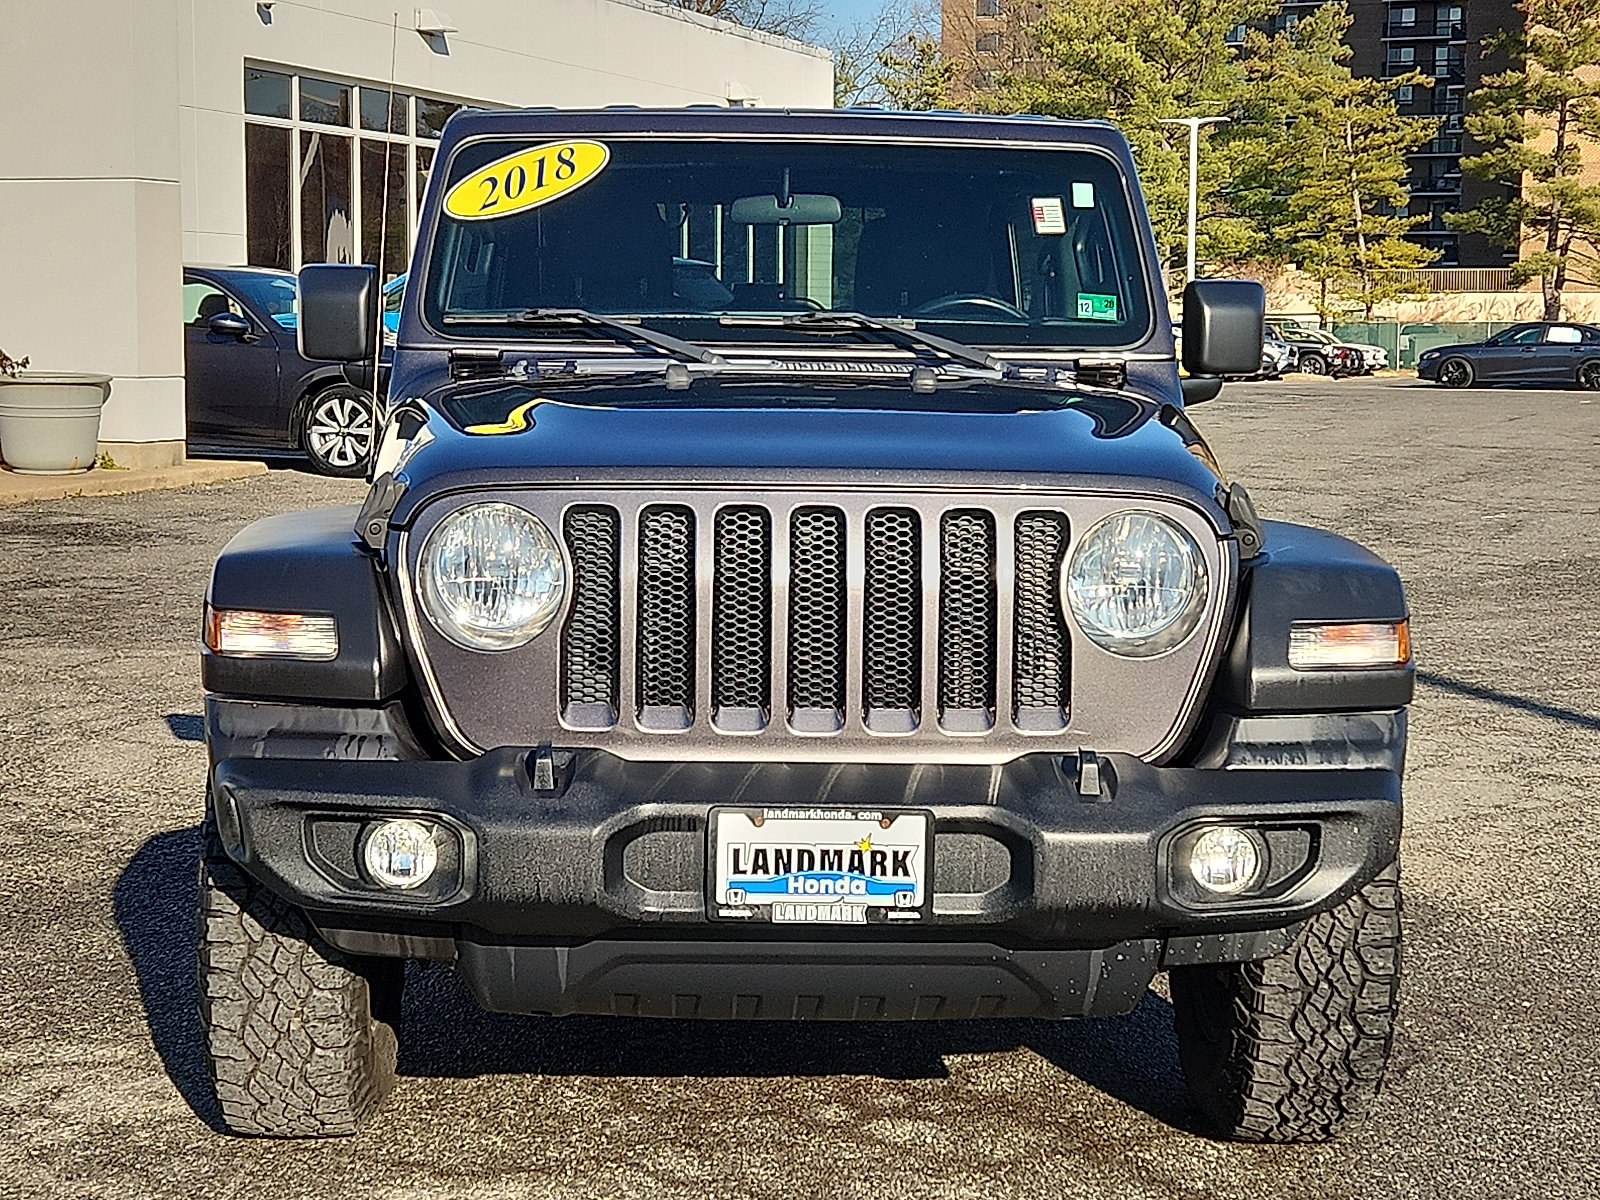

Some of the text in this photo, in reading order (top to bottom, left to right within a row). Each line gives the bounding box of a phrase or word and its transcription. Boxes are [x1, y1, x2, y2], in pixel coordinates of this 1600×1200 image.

[478, 147, 576, 211] 2018
[1079, 302, 1090, 313] 12
[732, 847, 912, 878] LANDMARK
[788, 875, 867, 896] Honda
[774, 903, 865, 923] LANDMARK
